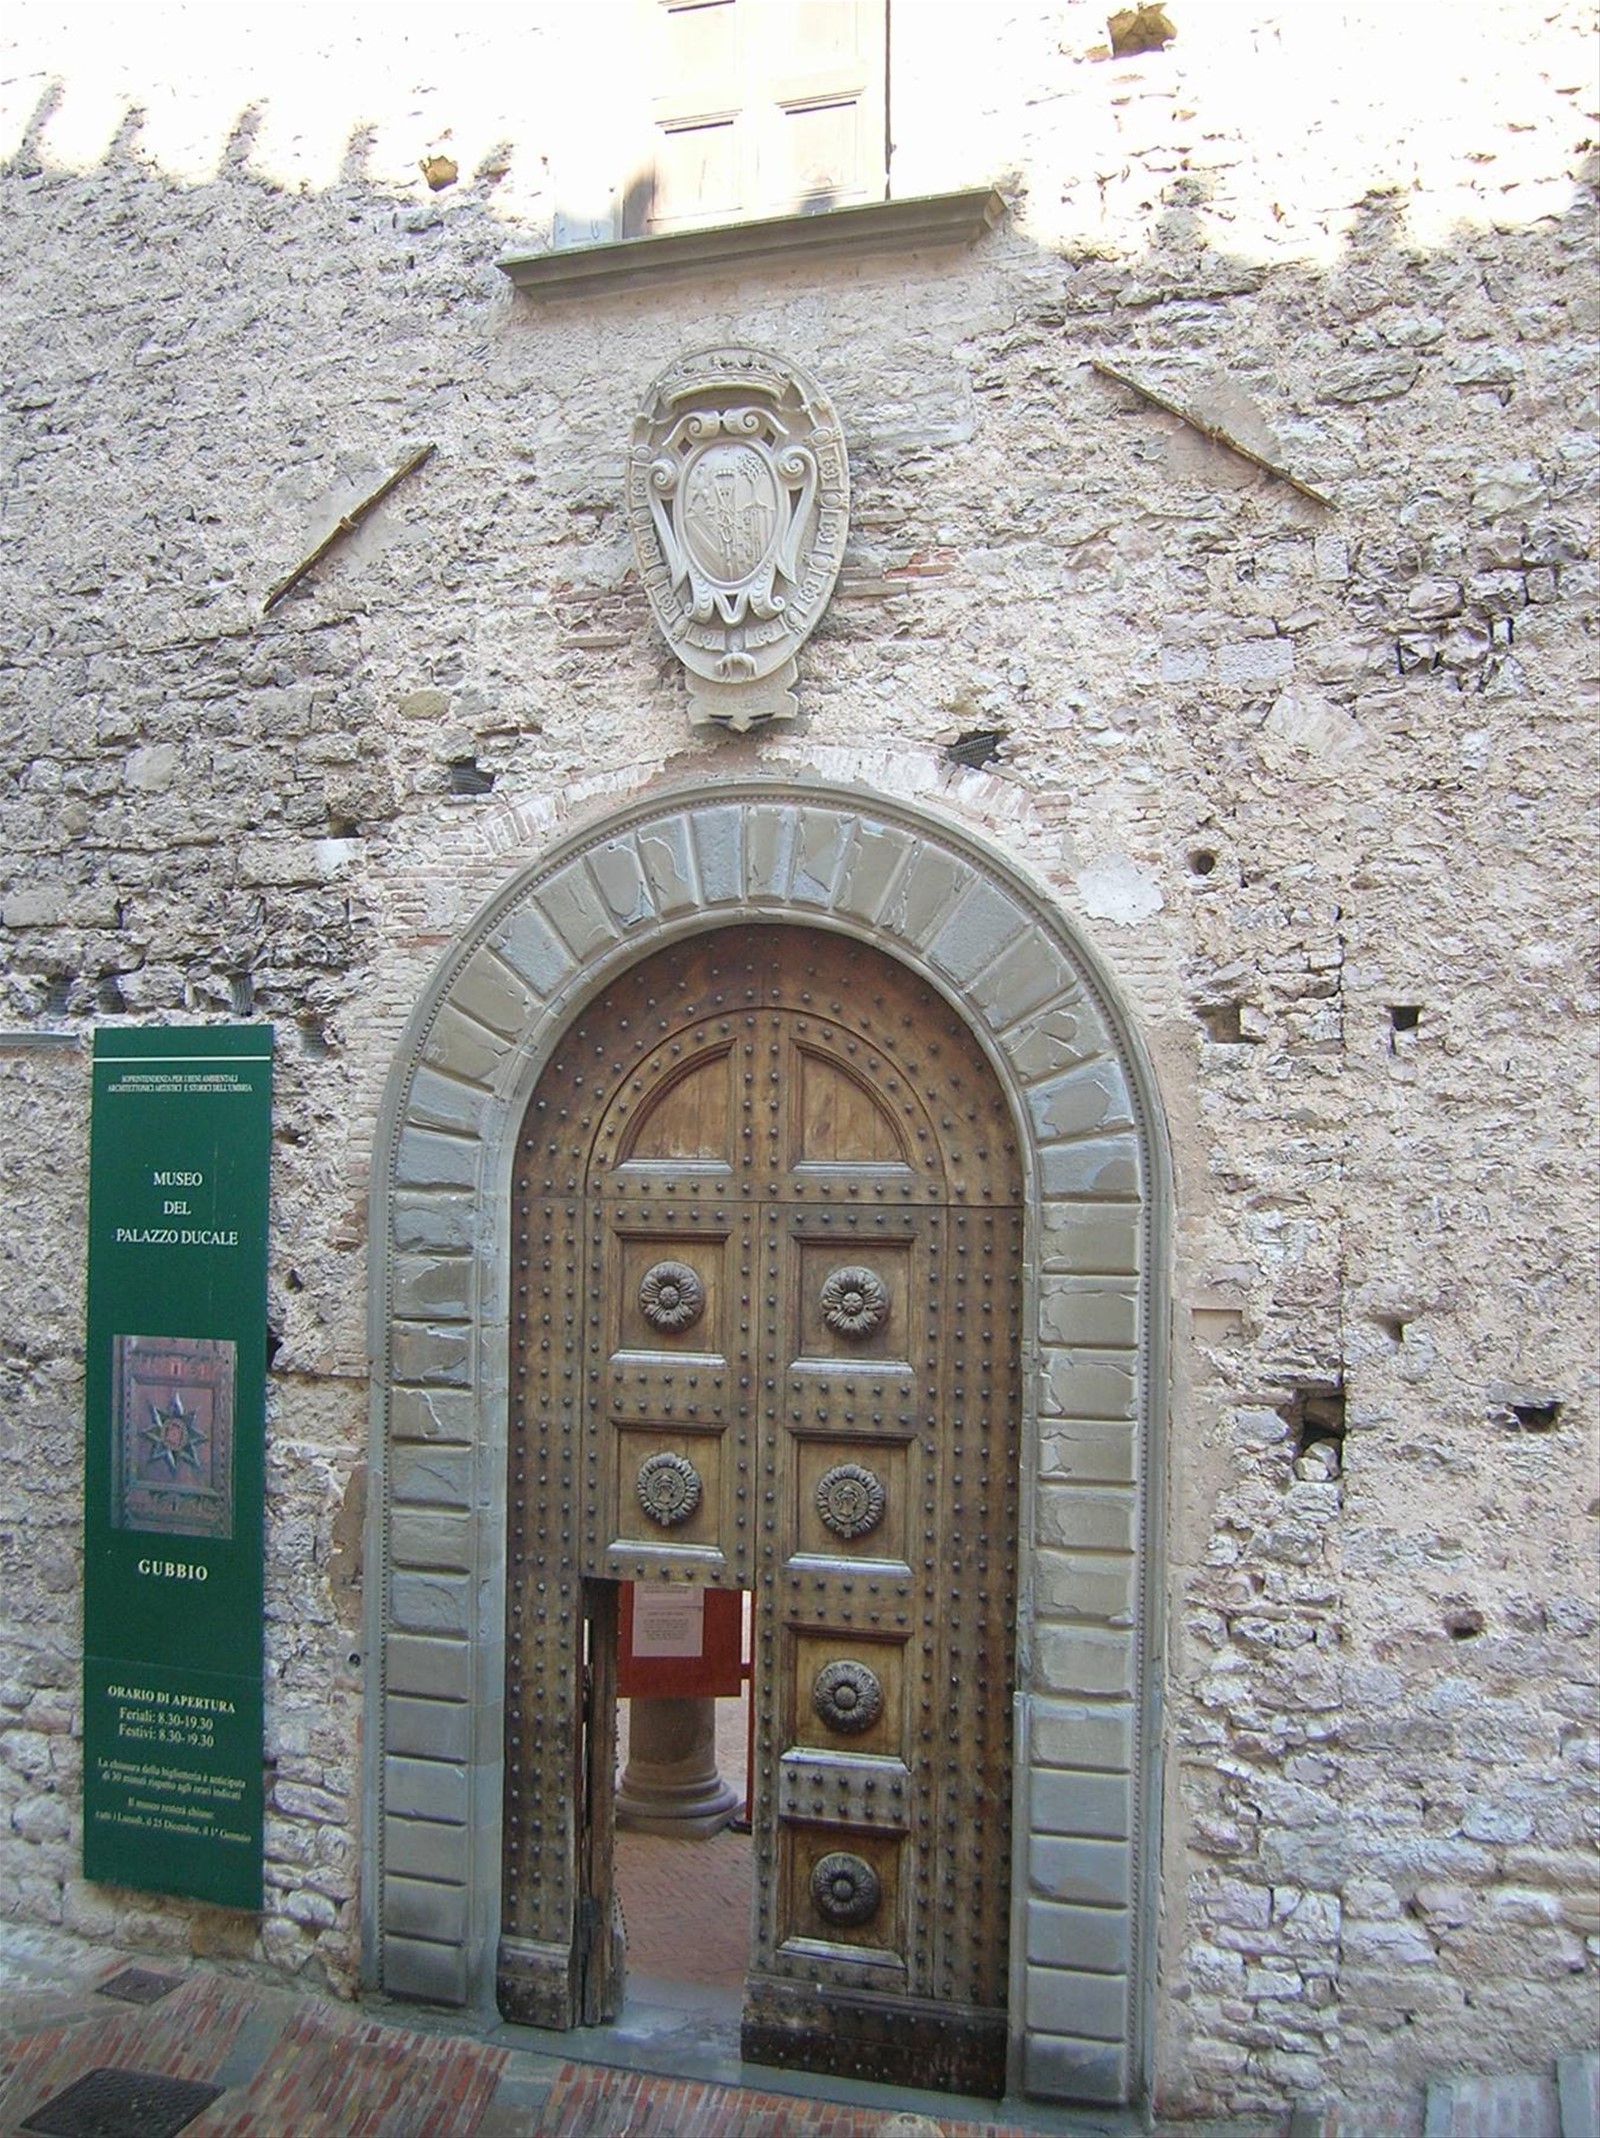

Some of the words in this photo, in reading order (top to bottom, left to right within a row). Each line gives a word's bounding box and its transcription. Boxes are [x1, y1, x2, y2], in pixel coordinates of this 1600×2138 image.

[153, 1171, 203, 1187] MUSEO
[163, 1201, 192, 1215] DEL
[115, 1227, 179, 1243] PALAZZO
[181, 1230, 239, 1246] DUCALE
[138, 1558, 208, 1582] GUBBIO
[107, 1685, 155, 1702] ORARIO
[157, 1691, 170, 1705] DI
[171, 1694, 236, 1714] APERTURA
[120, 1706, 156, 1723] Feriali:
[158, 1711, 214, 1731] 8.30-19.30
[119, 1722, 157, 1740] Festivi:
